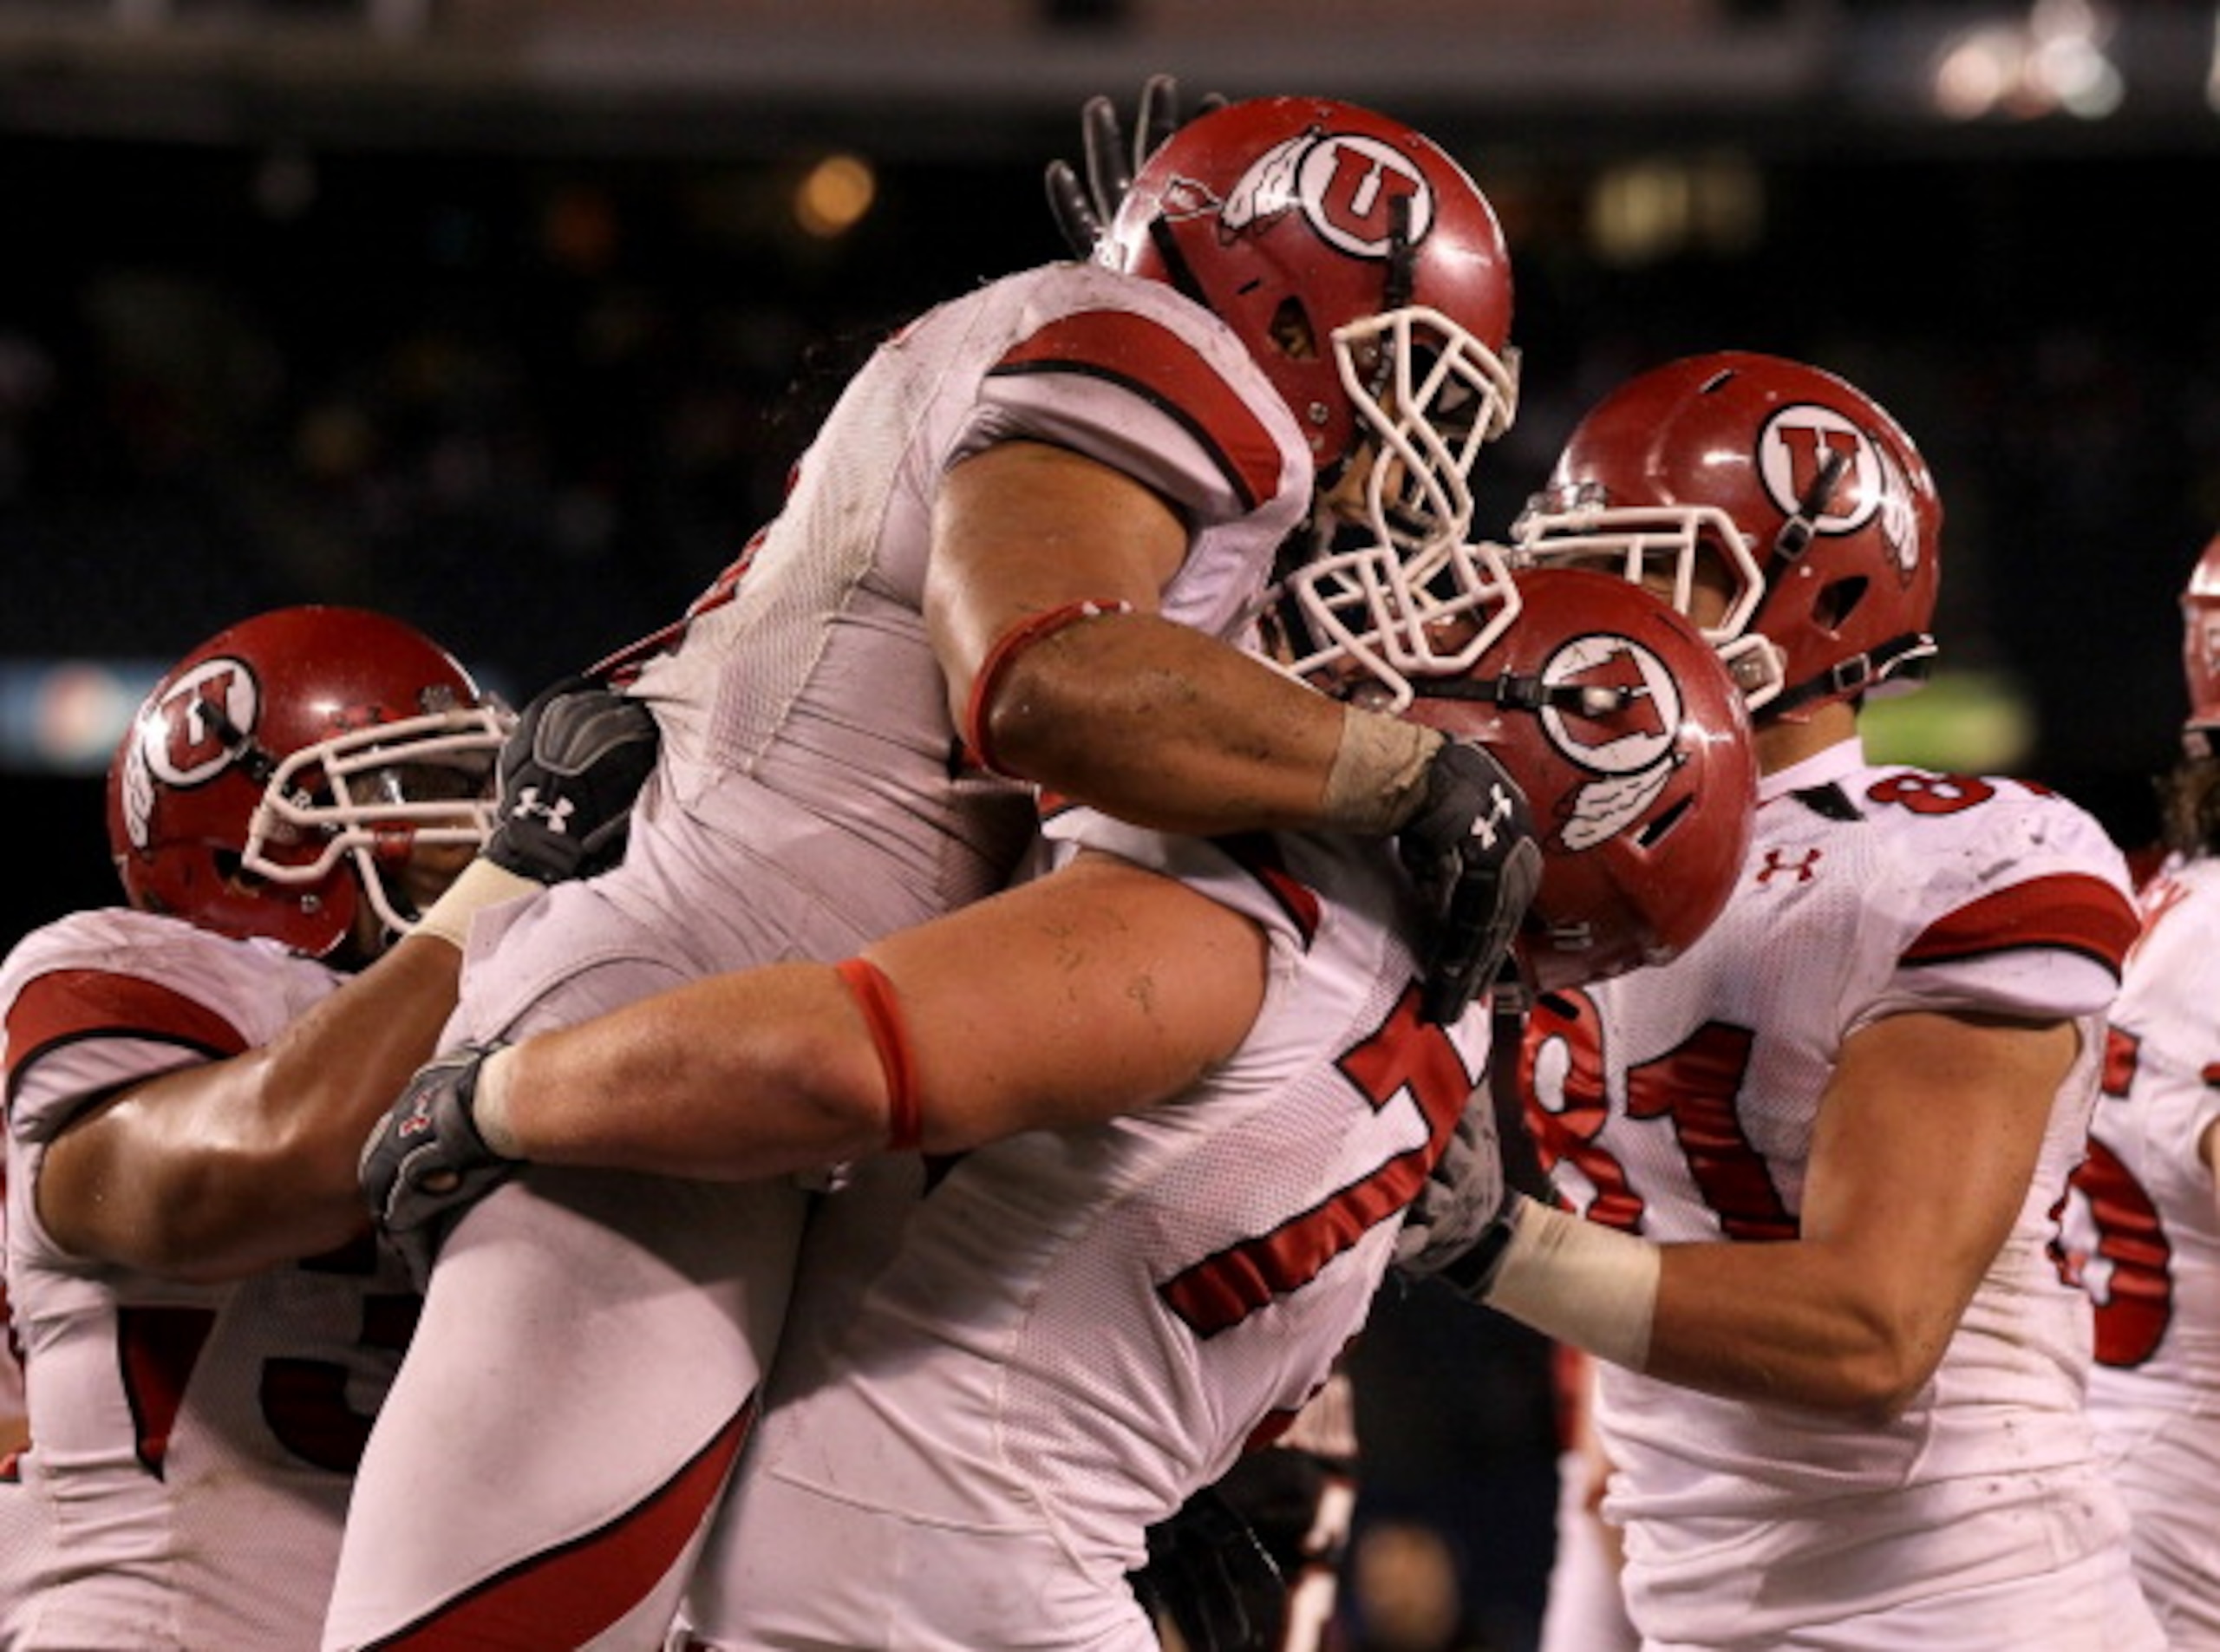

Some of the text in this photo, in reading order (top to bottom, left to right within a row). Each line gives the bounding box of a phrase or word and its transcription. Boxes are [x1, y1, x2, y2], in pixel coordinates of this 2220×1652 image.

[1320, 144, 1420, 245] U
[1778, 426, 1861, 519] U
[160, 669, 234, 773] U
[1518, 987, 1801, 1243] 81
